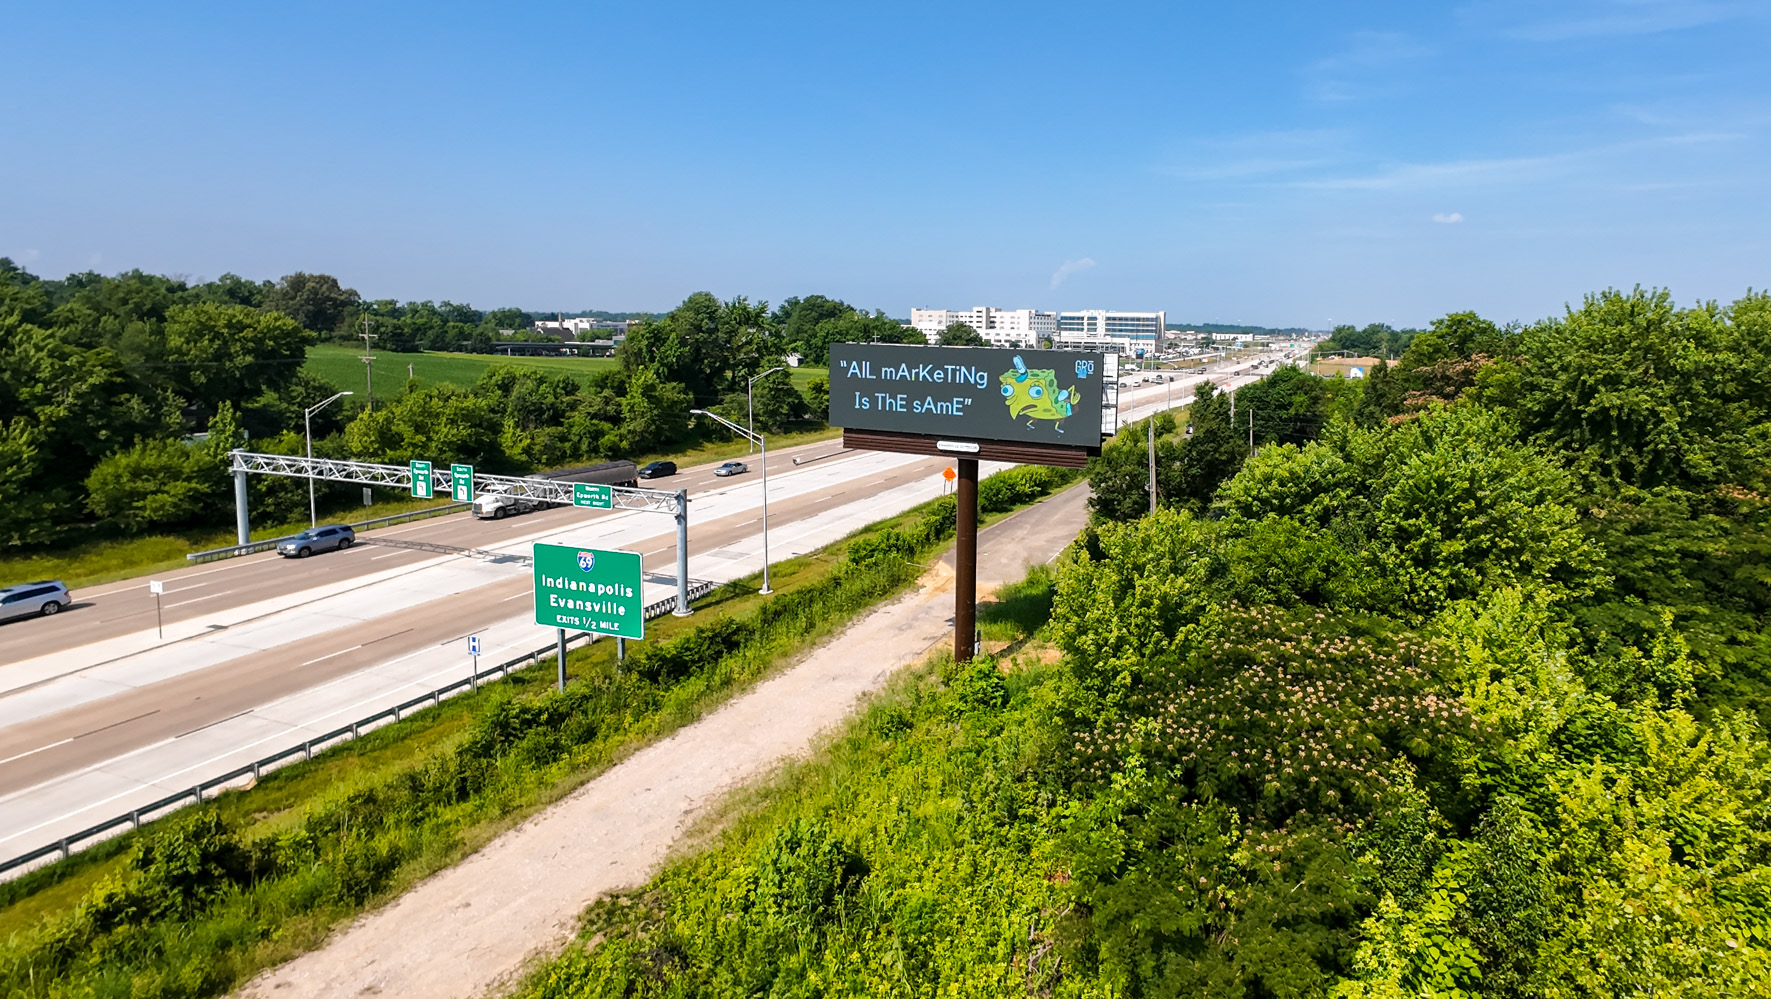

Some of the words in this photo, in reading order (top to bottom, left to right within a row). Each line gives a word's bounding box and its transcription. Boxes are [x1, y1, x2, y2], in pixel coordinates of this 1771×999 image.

[881, 363, 988, 389] mArKeTiNg
[854, 391, 870, 410] Is
[874, 393, 907, 412] ThE
[579, 556, 593, 568] 69
[542, 574, 633, 597] Indianapolis
[549, 594, 626, 616] Evansville
[556, 615, 580, 626] EXITS
[600, 621, 620, 631] MILE
